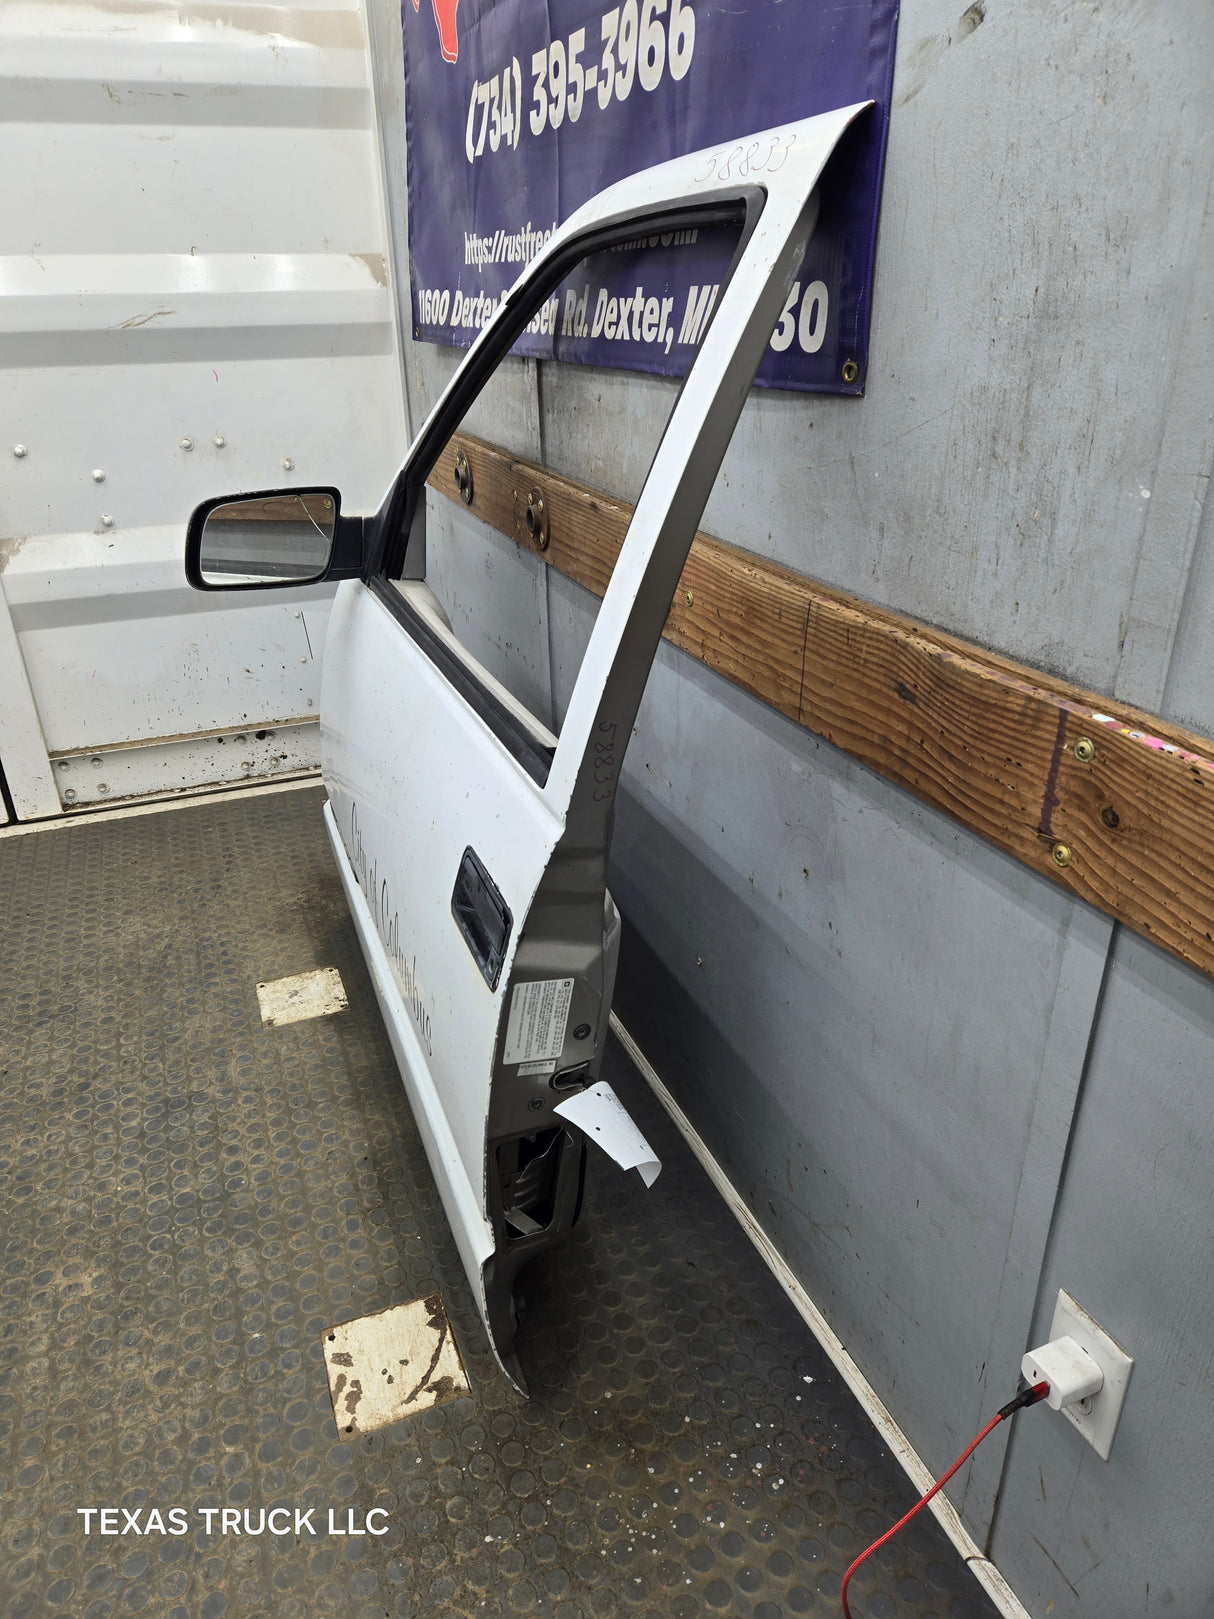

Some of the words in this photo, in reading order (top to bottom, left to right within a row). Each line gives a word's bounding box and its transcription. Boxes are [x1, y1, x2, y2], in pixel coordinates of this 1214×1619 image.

[465, 56, 522, 164] (734)
[529, 0, 696, 136] 395-3966
[694, 134, 797, 182] 58833
[418, 289, 450, 325] 11600
[561, 283, 589, 338] Rd.
[591, 286, 674, 355] Dexter,
[593, 721, 617, 802] 58833
